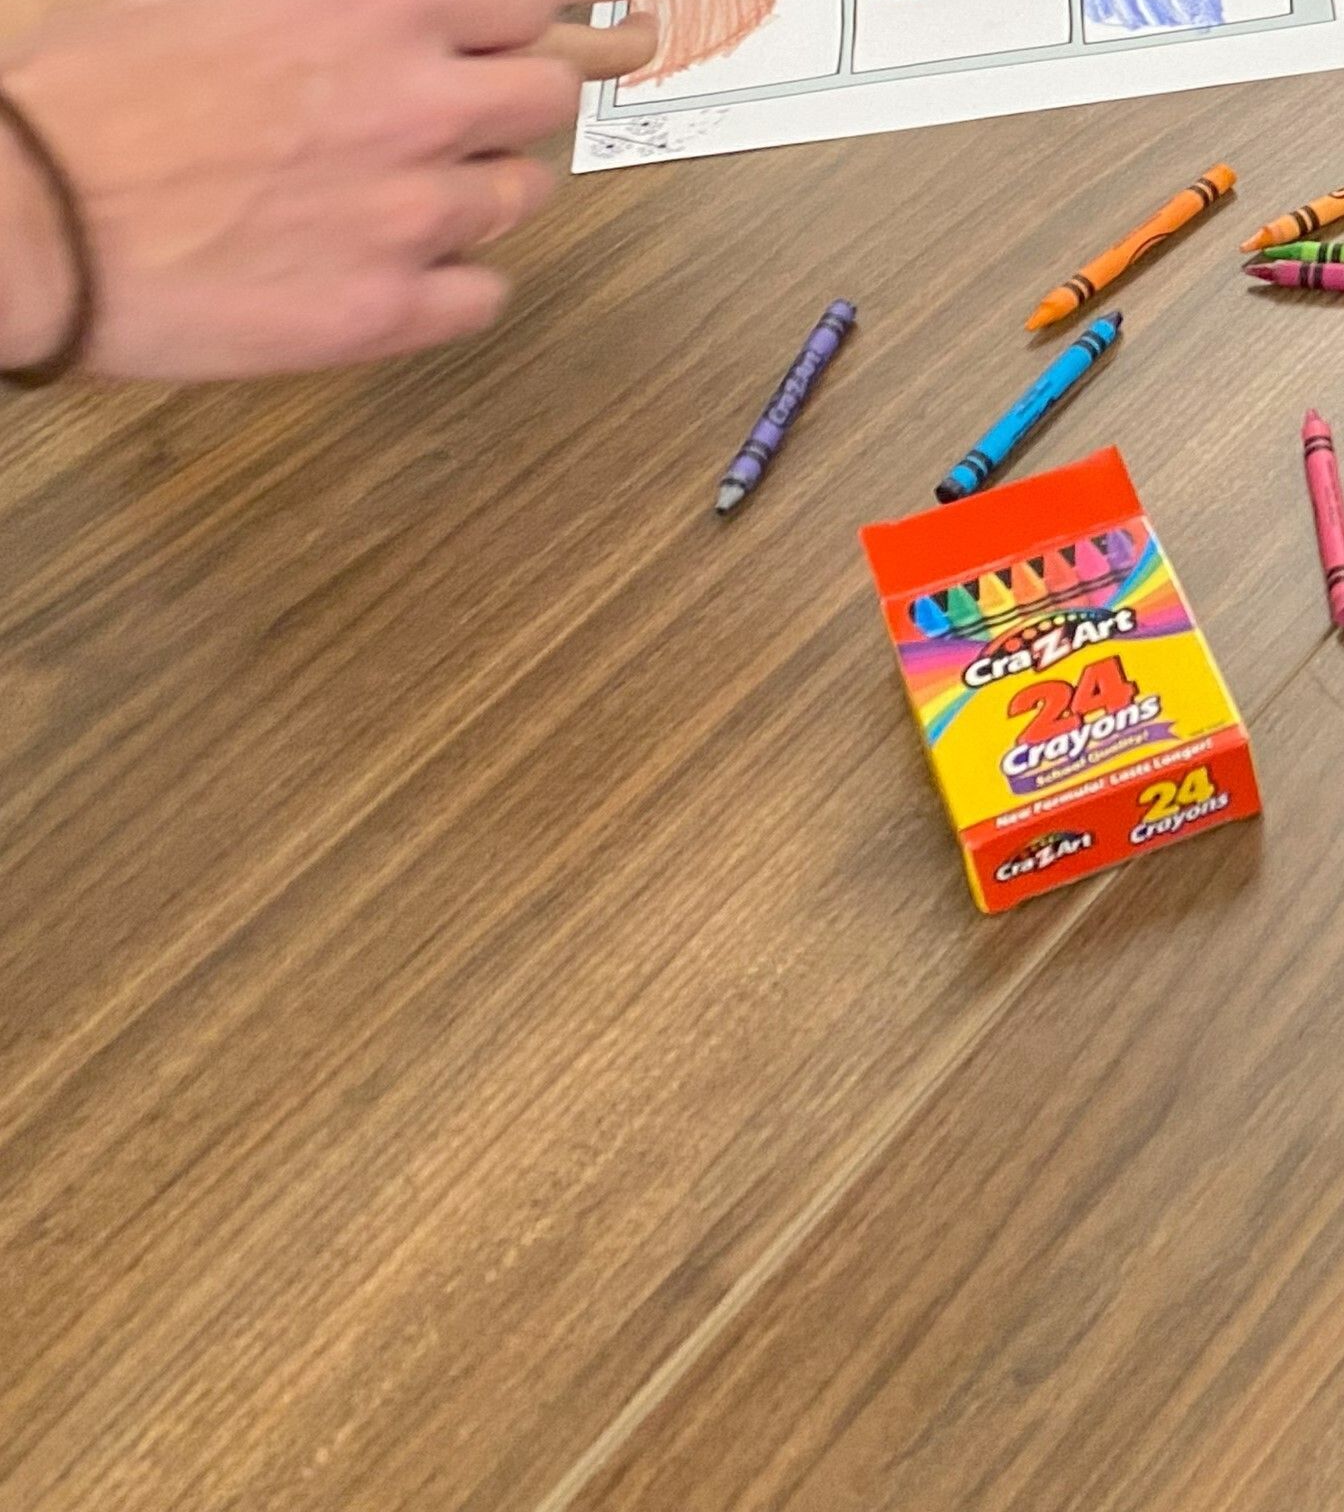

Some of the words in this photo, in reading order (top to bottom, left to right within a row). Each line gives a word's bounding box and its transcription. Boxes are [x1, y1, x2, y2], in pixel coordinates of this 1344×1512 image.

[1001, 695, 1161, 777] Crayons
[1006, 654, 1140, 746] 24
[995, 806, 1032, 829] New
[1033, 778, 1105, 814] Formula!
[1109, 762, 1152, 786] Lasts
[1152, 739, 1213, 770] Longer!
[1129, 792, 1229, 844] Crayons
[1138, 766, 1216, 825] 24
